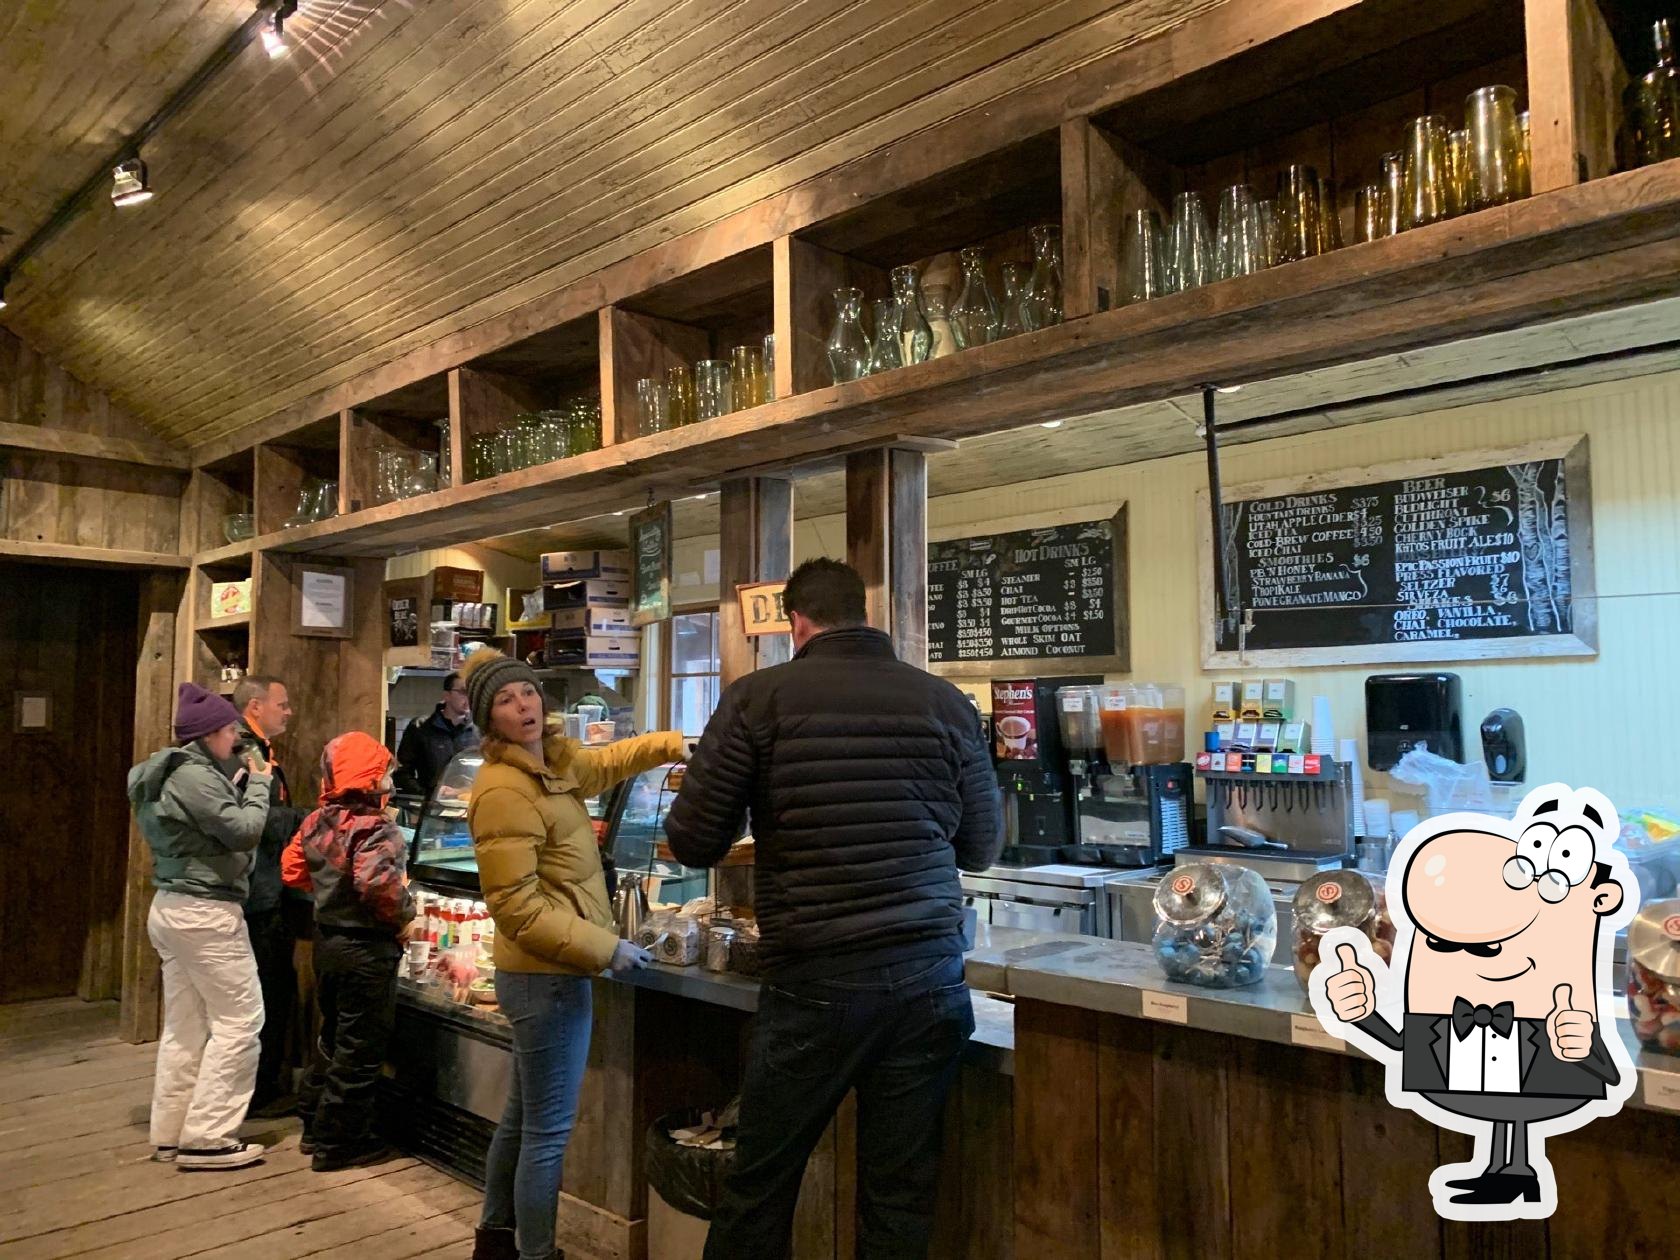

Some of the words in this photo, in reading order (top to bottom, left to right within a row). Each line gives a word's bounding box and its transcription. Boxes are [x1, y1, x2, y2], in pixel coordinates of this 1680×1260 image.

[1402, 478, 1445, 493] BEER
[1394, 486, 1469, 504] BUDWEISER
[1250, 501, 1285, 513] COLD
[1286, 494, 1338, 508] DRINKS
[1249, 509, 1294, 522] FOUNTAIN
[1296, 504, 1335, 516] DRINKS
[1394, 507, 1469, 523] CUTTHROAT
[1249, 521, 1279, 532] UTAH
[1281, 515, 1317, 528] APPLE
[1394, 520, 1445, 534] GOLDEN
[1449, 514, 1490, 528] SPIKE
[1249, 530, 1272, 540] ICED
[1277, 528, 1297, 537] TEA
[1312, 529, 1354, 542] COFFEE
[1431, 537, 1467, 550] FRUIT
[1468, 535, 1495, 548] ALE
[1495, 533, 1514, 546] $10
[1014, 549, 1039, 564] HOT
[1040, 543, 1090, 560] DRINKS
[1249, 548, 1272, 558] ICED
[1274, 545, 1301, 556] CHAI
[928, 560, 958, 572] OFFEE
[1258, 553, 1334, 568] SMOOTHIES
[1395, 562, 1418, 572] EPIC
[1278, 564, 1315, 576] HONEY
[1315, 571, 1351, 582] BANANA
[1395, 570, 1434, 582] PRESS
[1438, 563, 1505, 578] FLAVORED
[1001, 574, 1041, 585] STEAMER
[1400, 577, 1456, 591] SELTZER
[1001, 586, 1023, 595] CHAI
[1323, 591, 1361, 602] MANGO
[1396, 590, 1449, 602] SIRVEZA
[1001, 597, 1019, 606] HOT
[1020, 595, 1039, 604] TEA
[1032, 604, 1057, 613] COCOA
[1001, 616, 1038, 626] GOURMET
[1038, 614, 1062, 623] COCOA
[1015, 625, 1040, 635] MILK
[1042, 623, 1080, 633] OPTIONS
[1001, 636, 1028, 646] WHOLE
[1033, 634, 1056, 644] SKIM
[1061, 632, 1082, 643] OAT
[1001, 646, 1039, 657] ALMOND
[1046, 645, 1086, 655] COCONUT
[993, 683, 1033, 703] Stephen's
